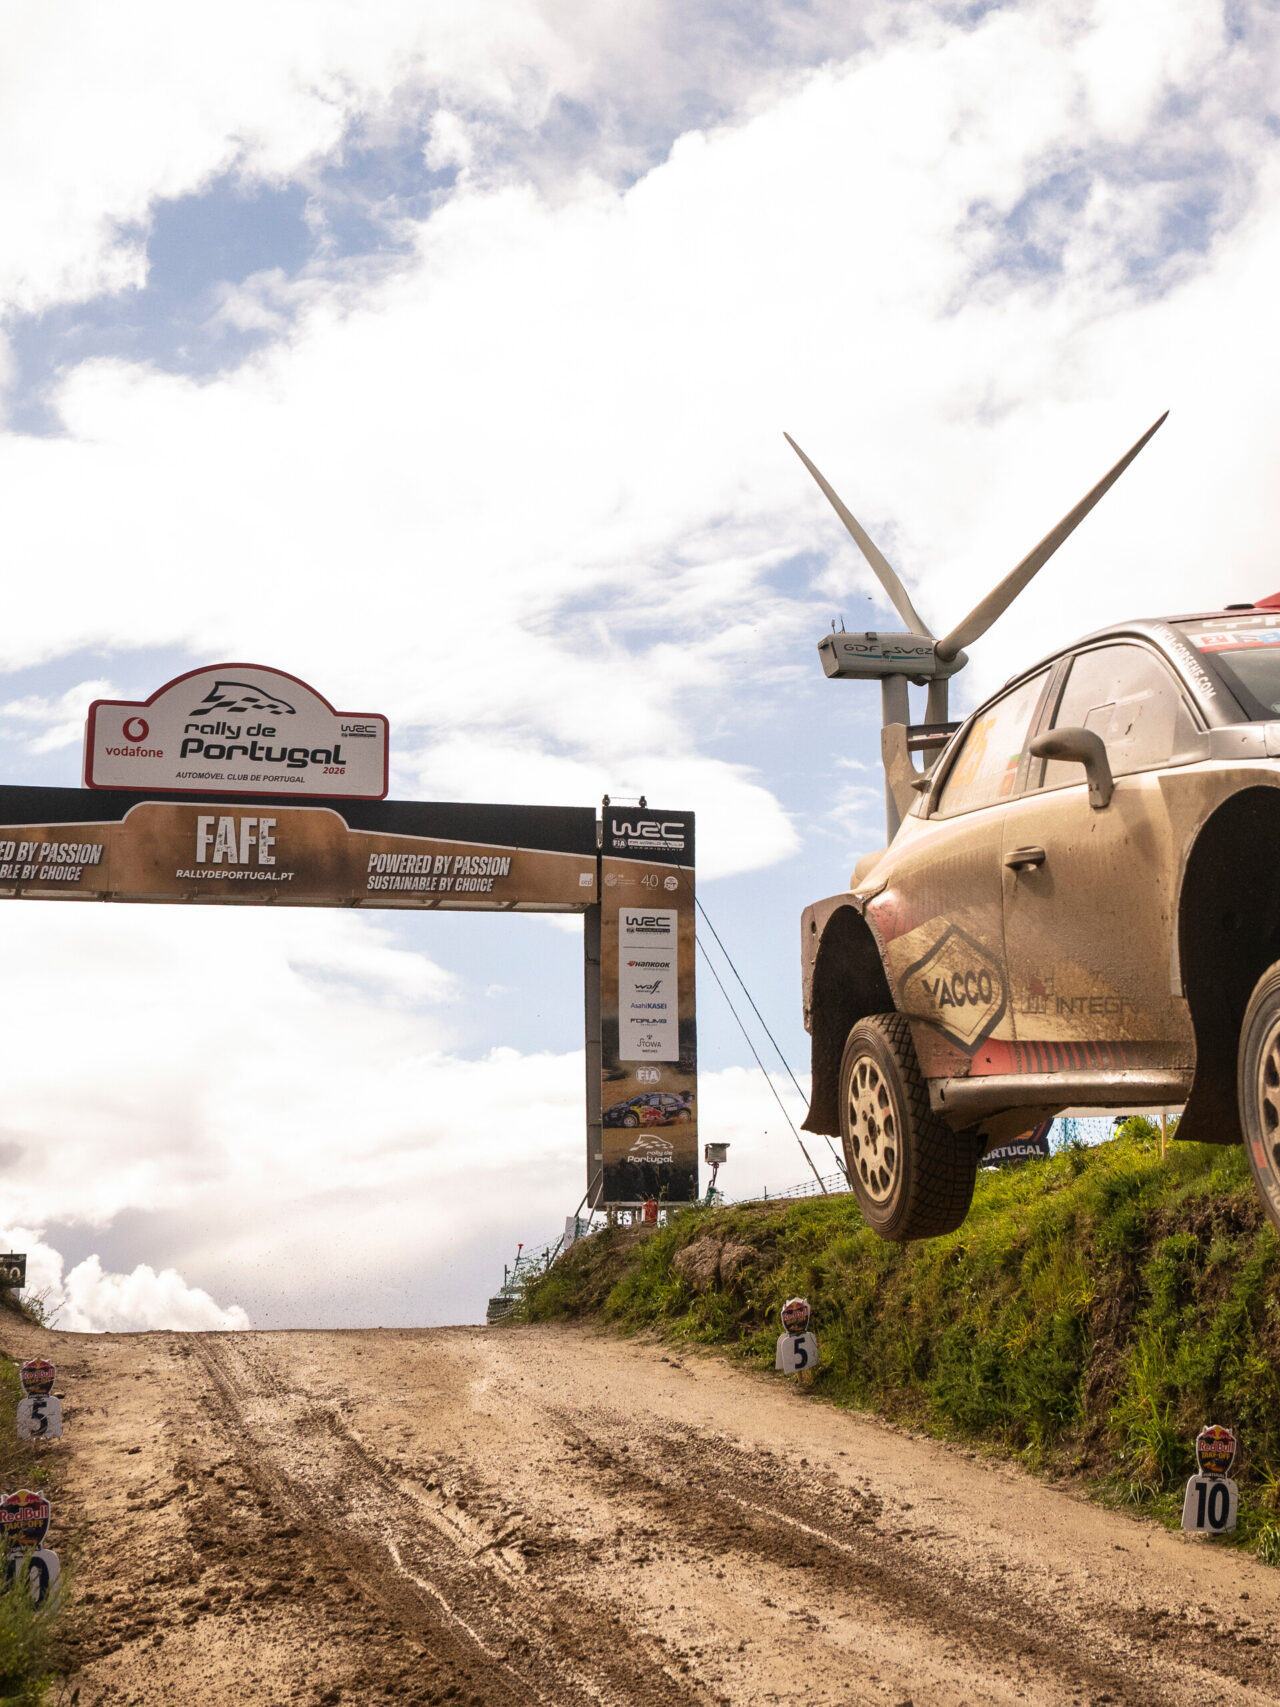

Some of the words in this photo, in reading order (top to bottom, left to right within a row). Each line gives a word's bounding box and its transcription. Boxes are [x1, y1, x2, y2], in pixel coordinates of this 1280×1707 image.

[843, 643, 878, 653] GDF
[184, 721, 241, 739] rally
[246, 723, 276, 737] de
[341, 724, 376, 733] WRC
[106, 746, 163, 758] vodafone
[180, 738, 346, 768] Portugal
[175, 771, 224, 780] AUTOMÓVEL
[227, 773, 248, 781] CLUB
[263, 775, 305, 783] PORTUGAL
[322, 766, 345, 774] 2026
[612, 819, 684, 838] WRC
[196, 815, 277, 865] FAFE
[16, 841, 38, 862] BY
[39, 842, 103, 865] PASSION
[21, 864, 39, 879] BY
[40, 865, 82, 881] CHOICE
[367, 853, 432, 874] POWERED
[433, 855, 453, 875] BY
[453, 855, 511, 876] PASSION
[175, 869, 295, 881] RALLYDEPORTUGAL.PT
[366, 875, 437, 891] SUSTAINABLE
[438, 877, 454, 891] BY
[454, 877, 494, 892] CHOICE
[626, 916, 671, 927] WRC
[920, 970, 994, 1011] YACCO
[628, 1155, 674, 1164] Portugal
[793, 1337, 808, 1370] 5
[30, 1401, 48, 1436] 5
[1200, 1442, 1216, 1451] Red
[1217, 1441, 1234, 1451] Bull
[0, 1507, 23, 1521] Red
[25, 1505, 48, 1520] Bull
[1195, 1482, 1230, 1529] 10
